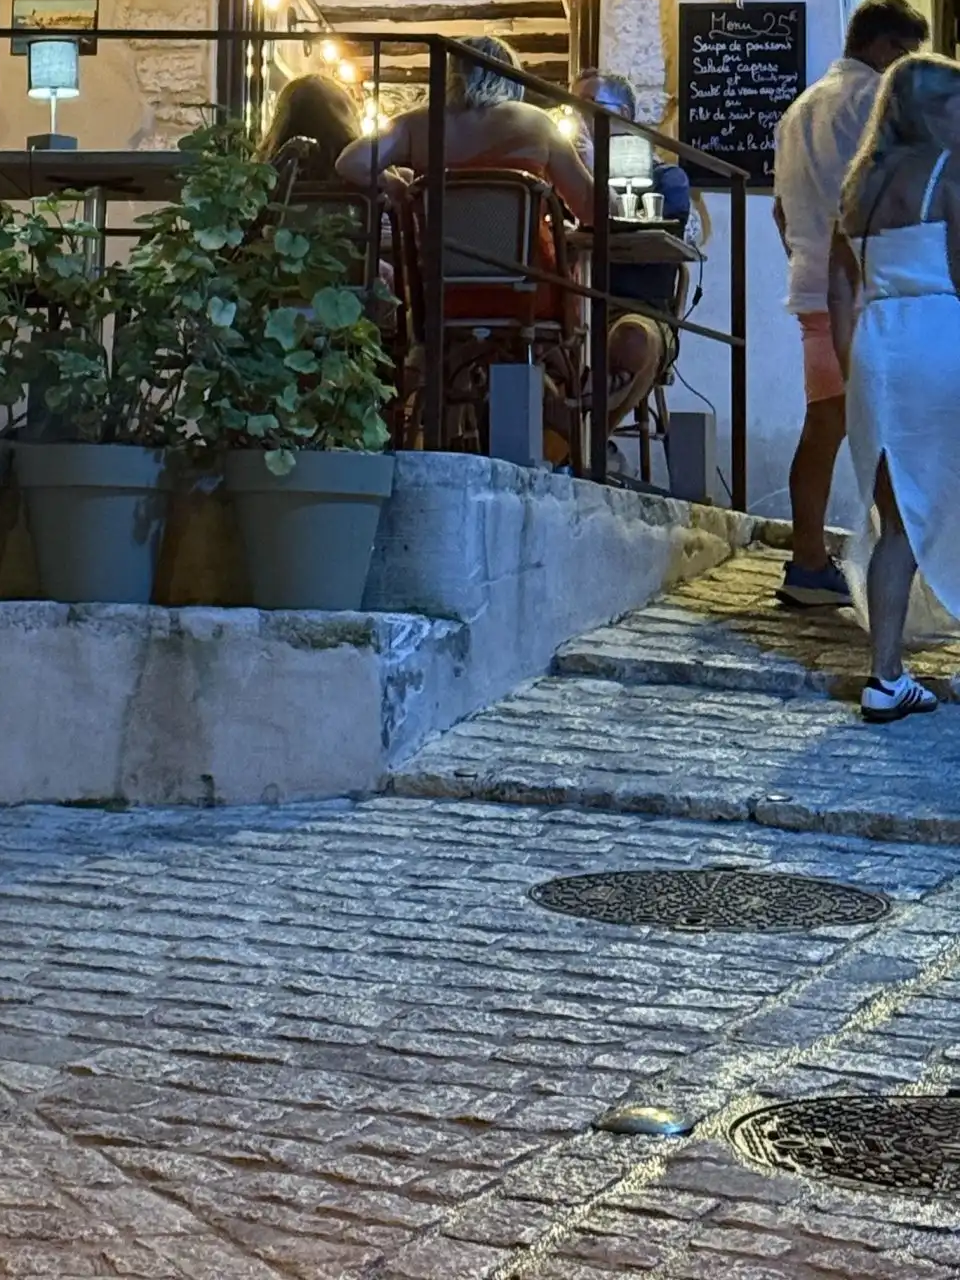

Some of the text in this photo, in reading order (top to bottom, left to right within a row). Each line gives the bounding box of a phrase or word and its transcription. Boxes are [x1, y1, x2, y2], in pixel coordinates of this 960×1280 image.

[709, 11, 753, 32] Menu
[692, 35, 727, 57] Soupe
[728, 39, 741, 52] de
[692, 57, 731, 75] Salade
[723, 54, 741, 63] ou
[723, 84, 737, 97] de
[725, 99, 741, 108] ou
[690, 107, 711, 122] Filet
[713, 108, 726, 121] de
[721, 121, 735, 137] et
